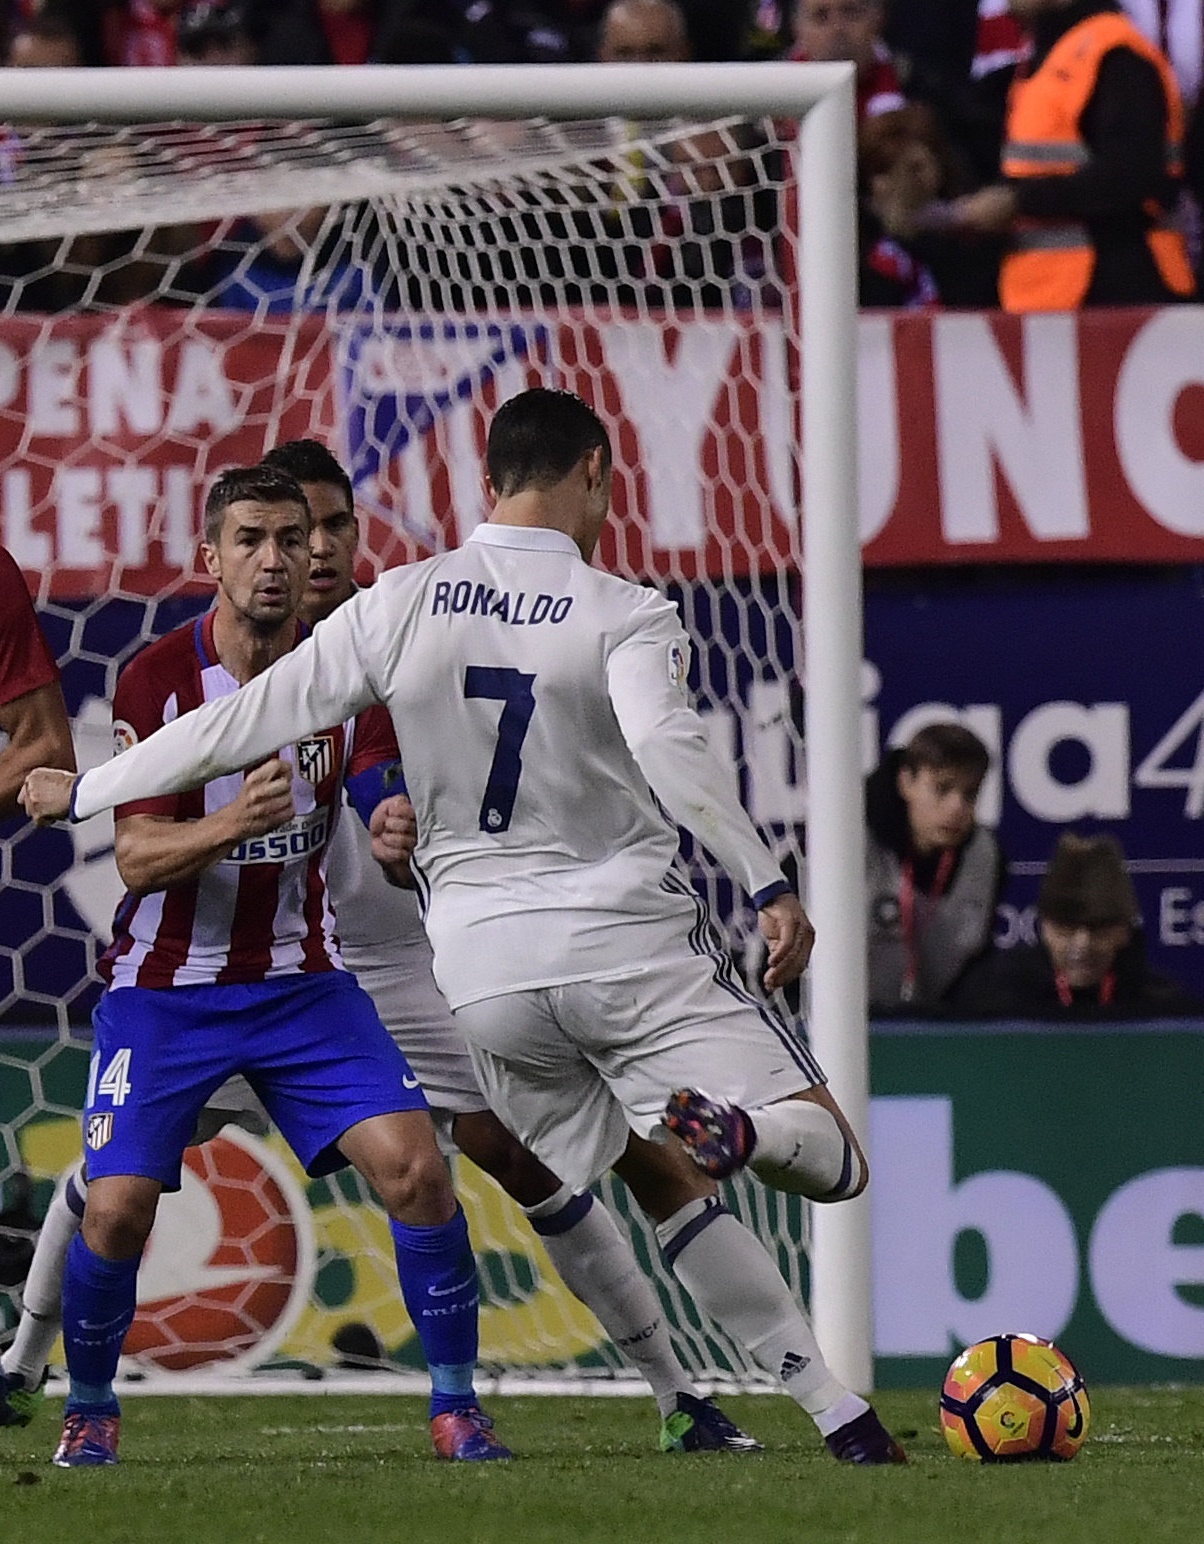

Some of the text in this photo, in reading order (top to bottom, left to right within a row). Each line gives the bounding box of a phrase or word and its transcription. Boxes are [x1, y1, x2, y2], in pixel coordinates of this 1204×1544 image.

[431, 580, 573, 625] RONALDO
[464, 665, 537, 834] 7
[86, 1048, 132, 1110] 14
